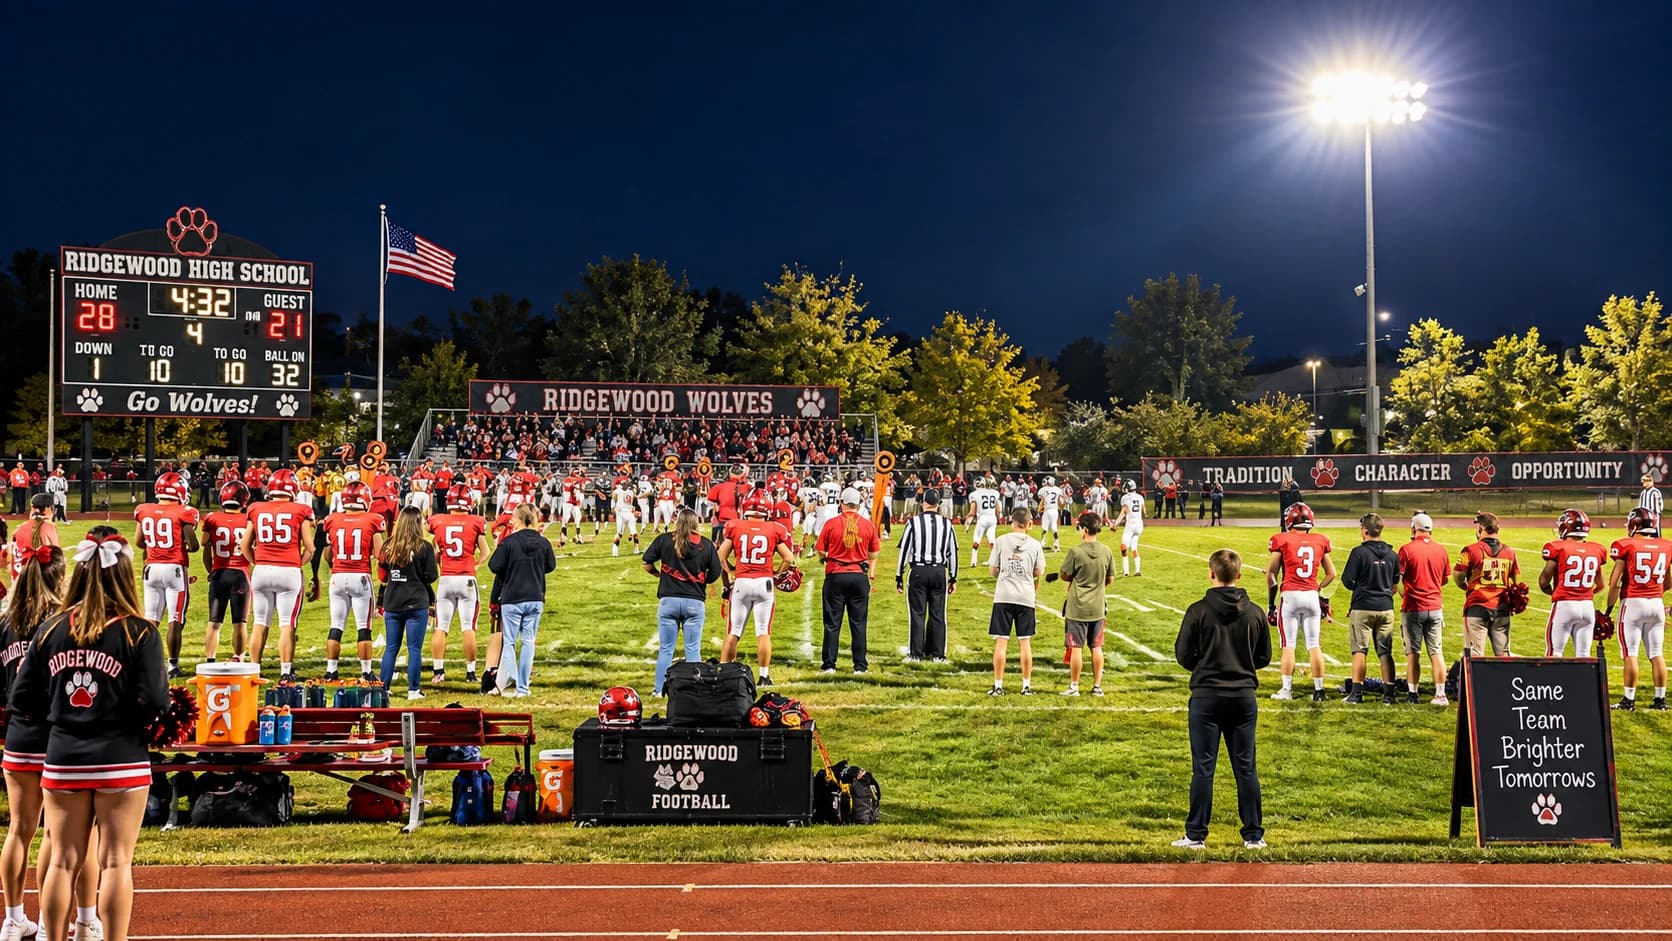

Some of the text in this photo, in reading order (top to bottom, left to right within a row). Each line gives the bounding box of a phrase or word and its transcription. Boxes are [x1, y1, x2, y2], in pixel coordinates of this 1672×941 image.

[65, 251, 310, 285] RIDGEWOOD HIGH SCHOOL
[75, 283, 117, 300] HOME
[171, 287, 230, 316] 4:32
[264, 293, 305, 310] GUEST
[79, 303, 115, 330] 28
[269, 312, 301, 337] 21
[187, 323, 203, 345] 4
[75, 342, 112, 355] DOWN
[214, 347, 247, 360] TO GO
[265, 350, 305, 362] BALL ON
[93, 357, 100, 380] 1
[149, 359, 171, 382] 10
[224, 361, 245, 384] 10
[271, 363, 300, 386] 32
[127, 389, 259, 414] Go Wolves!
[543, 388, 773, 414] RIDGEWOOD WOLVES
[1202, 461, 1623, 484] TRADITION CHARACTER OPPORTUNITY
[141, 516, 174, 549] 99
[257, 512, 293, 544] 65
[336, 528, 363, 561] 11
[445, 525, 464, 558] 5
[739, 533, 770, 565] 12
[1295, 545, 1315, 578] 3
[1563, 555, 1599, 588] 28
[1633, 552, 1668, 585] 54
[48, 649, 123, 679] RIDGEWOOD
[207, 685, 231, 712] G
[1511, 677, 1564, 701] Same
[1511, 706, 1567, 730] Team
[644, 744, 739, 763] RIDGEWOOD
[1501, 735, 1585, 767] Brighter
[544, 770, 563, 790] G
[1491, 765, 1597, 788] Tomorrows
[651, 794, 731, 809] FOOTBALL
